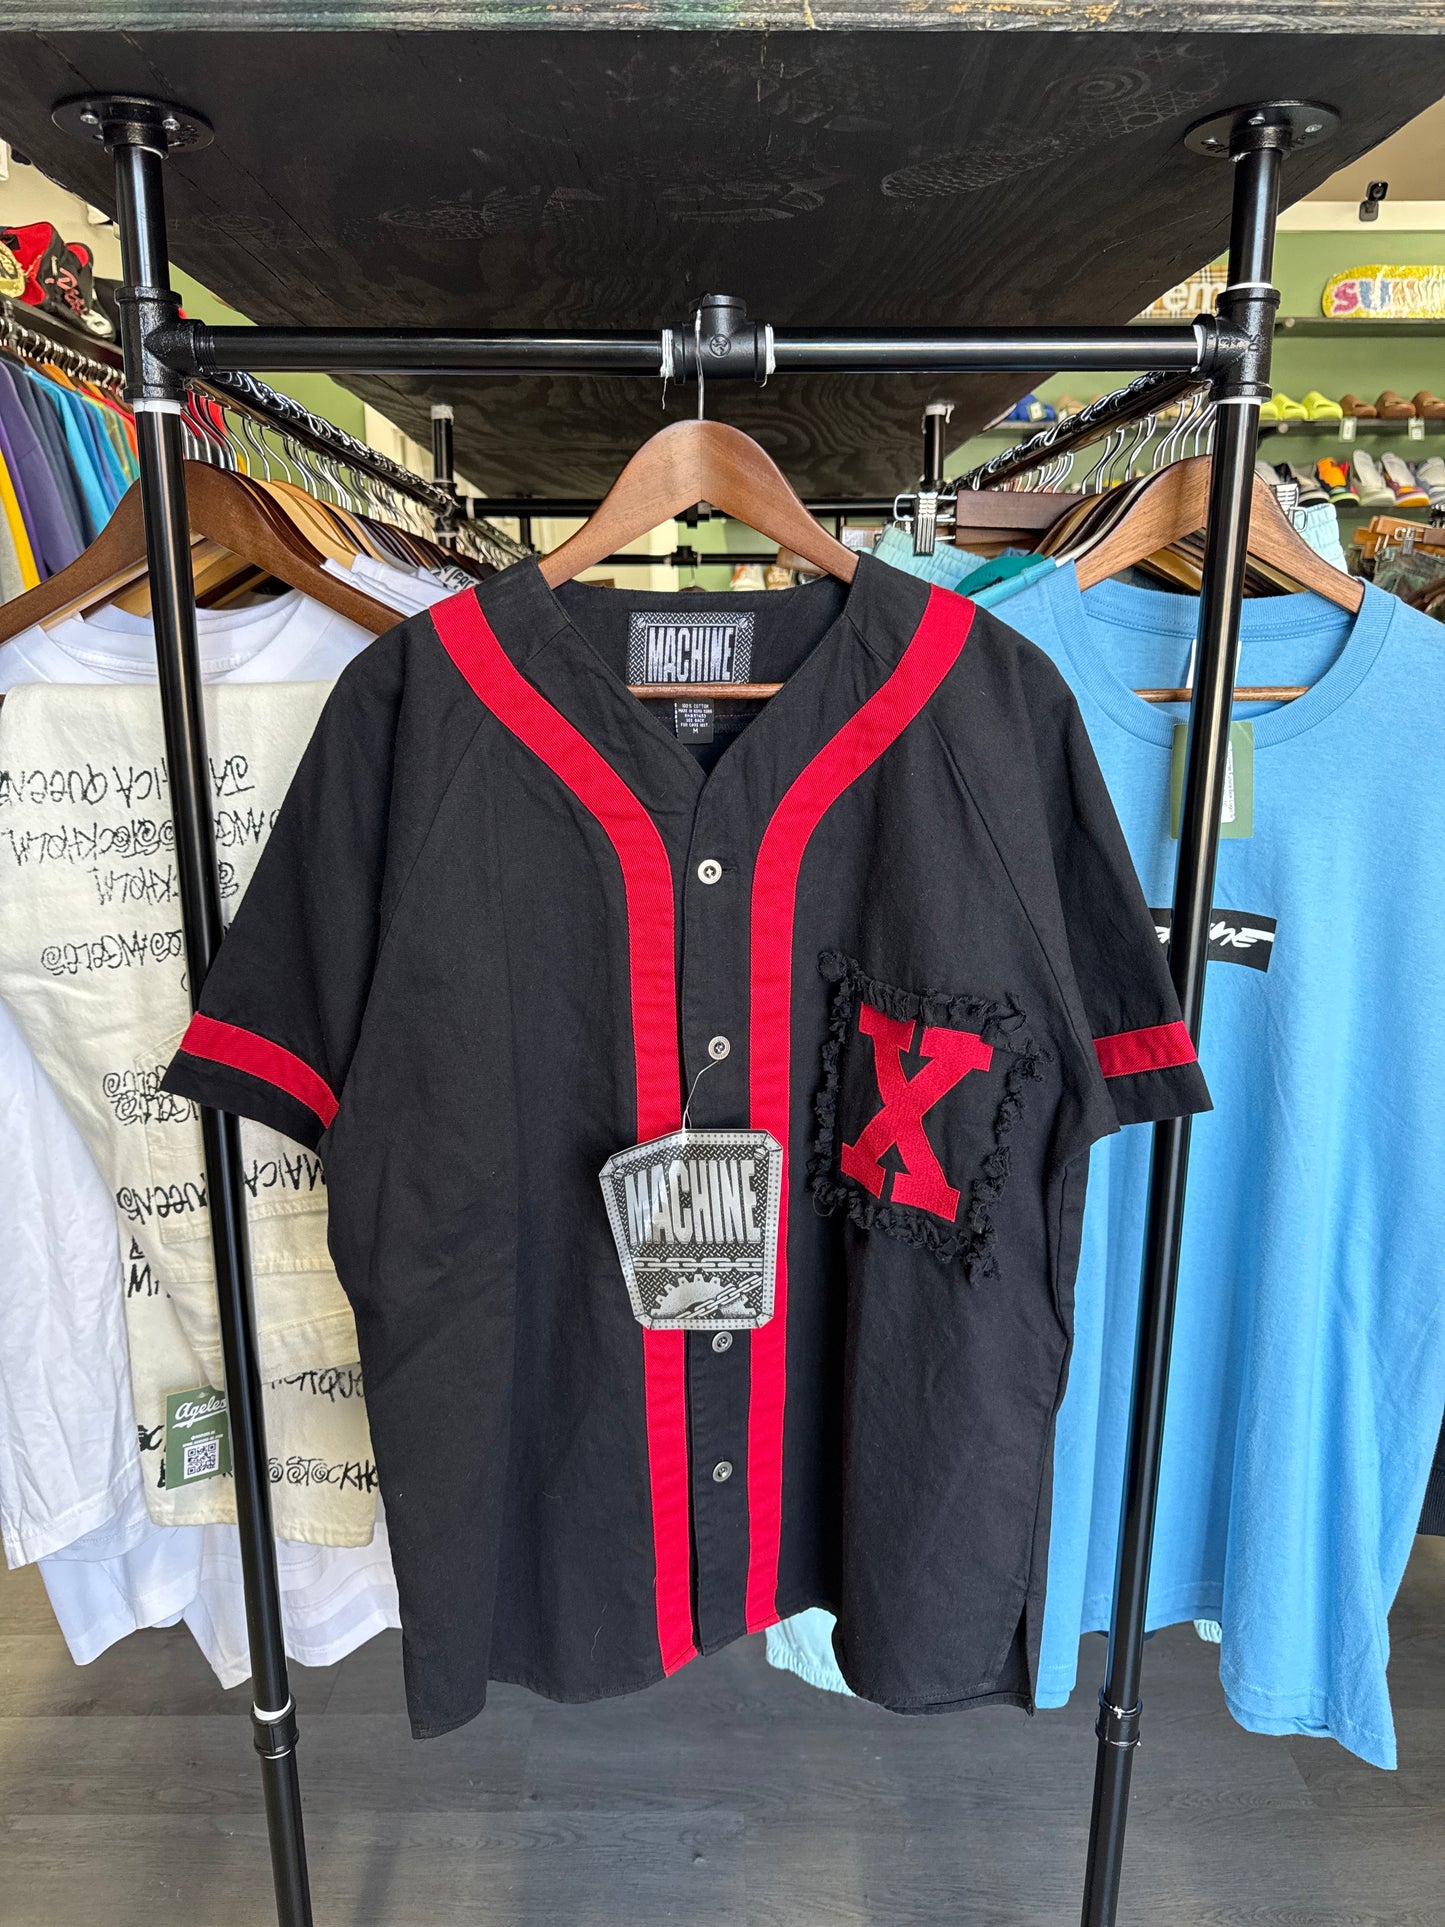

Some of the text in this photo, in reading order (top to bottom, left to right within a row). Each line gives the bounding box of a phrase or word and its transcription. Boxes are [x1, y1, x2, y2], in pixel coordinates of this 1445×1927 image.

[647, 627, 734, 682] MACHINE
[840, 1001, 994, 1223] X
[624, 1159, 763, 1246] MACHINE
[173, 1396, 227, 1426] Ageles
